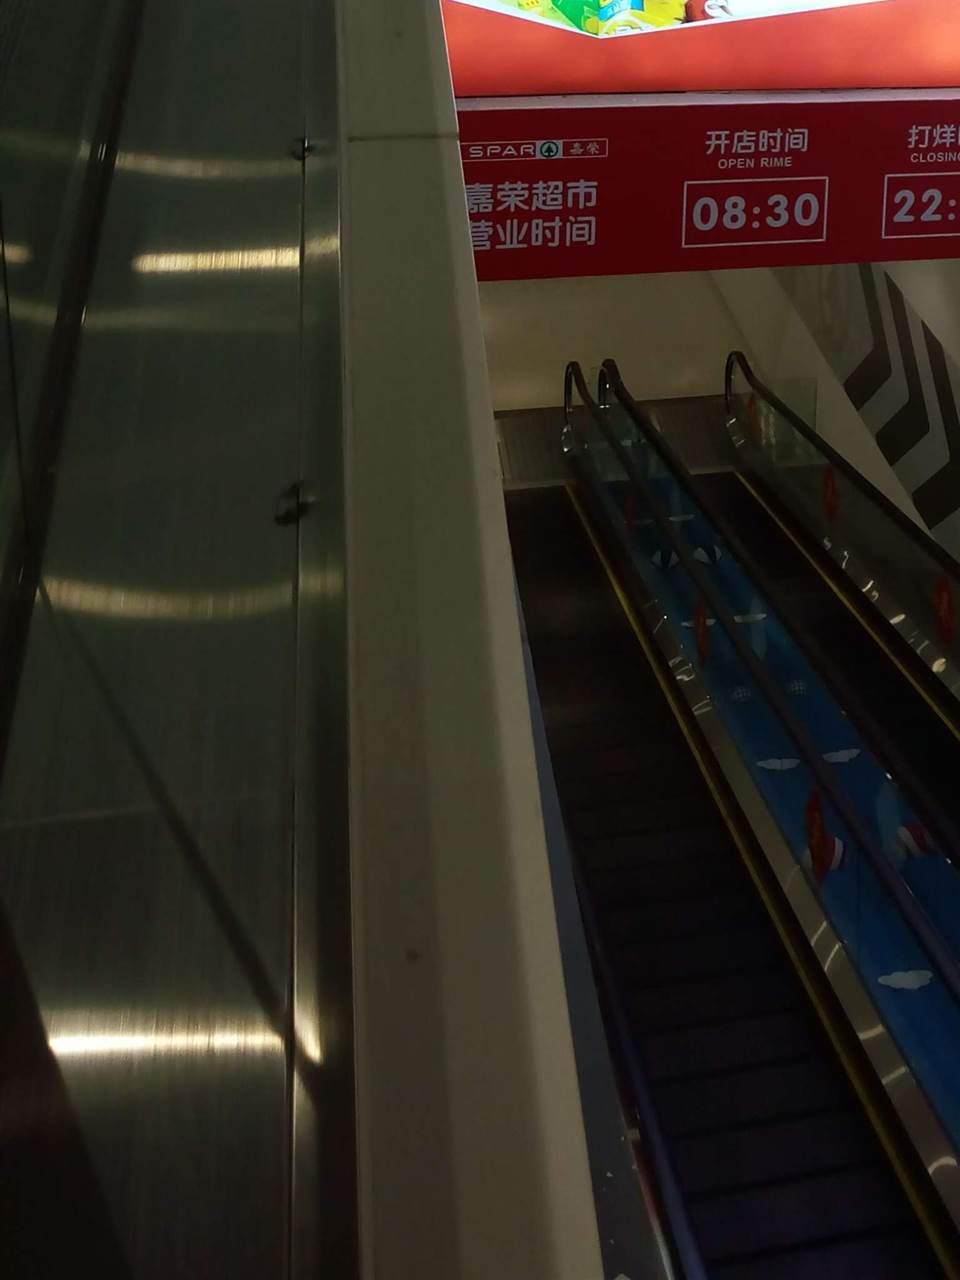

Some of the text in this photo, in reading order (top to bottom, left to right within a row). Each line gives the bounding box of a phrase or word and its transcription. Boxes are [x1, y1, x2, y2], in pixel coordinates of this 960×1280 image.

[468, 144, 535, 158] SPAR
[705, 127, 808, 155] 开店时间
[718, 156, 792, 169] OPEN RIME
[466, 179, 598, 213] 嘉荣超市
[692, 192, 820, 231] 08:30
[470, 216, 596, 251] 营业时间
